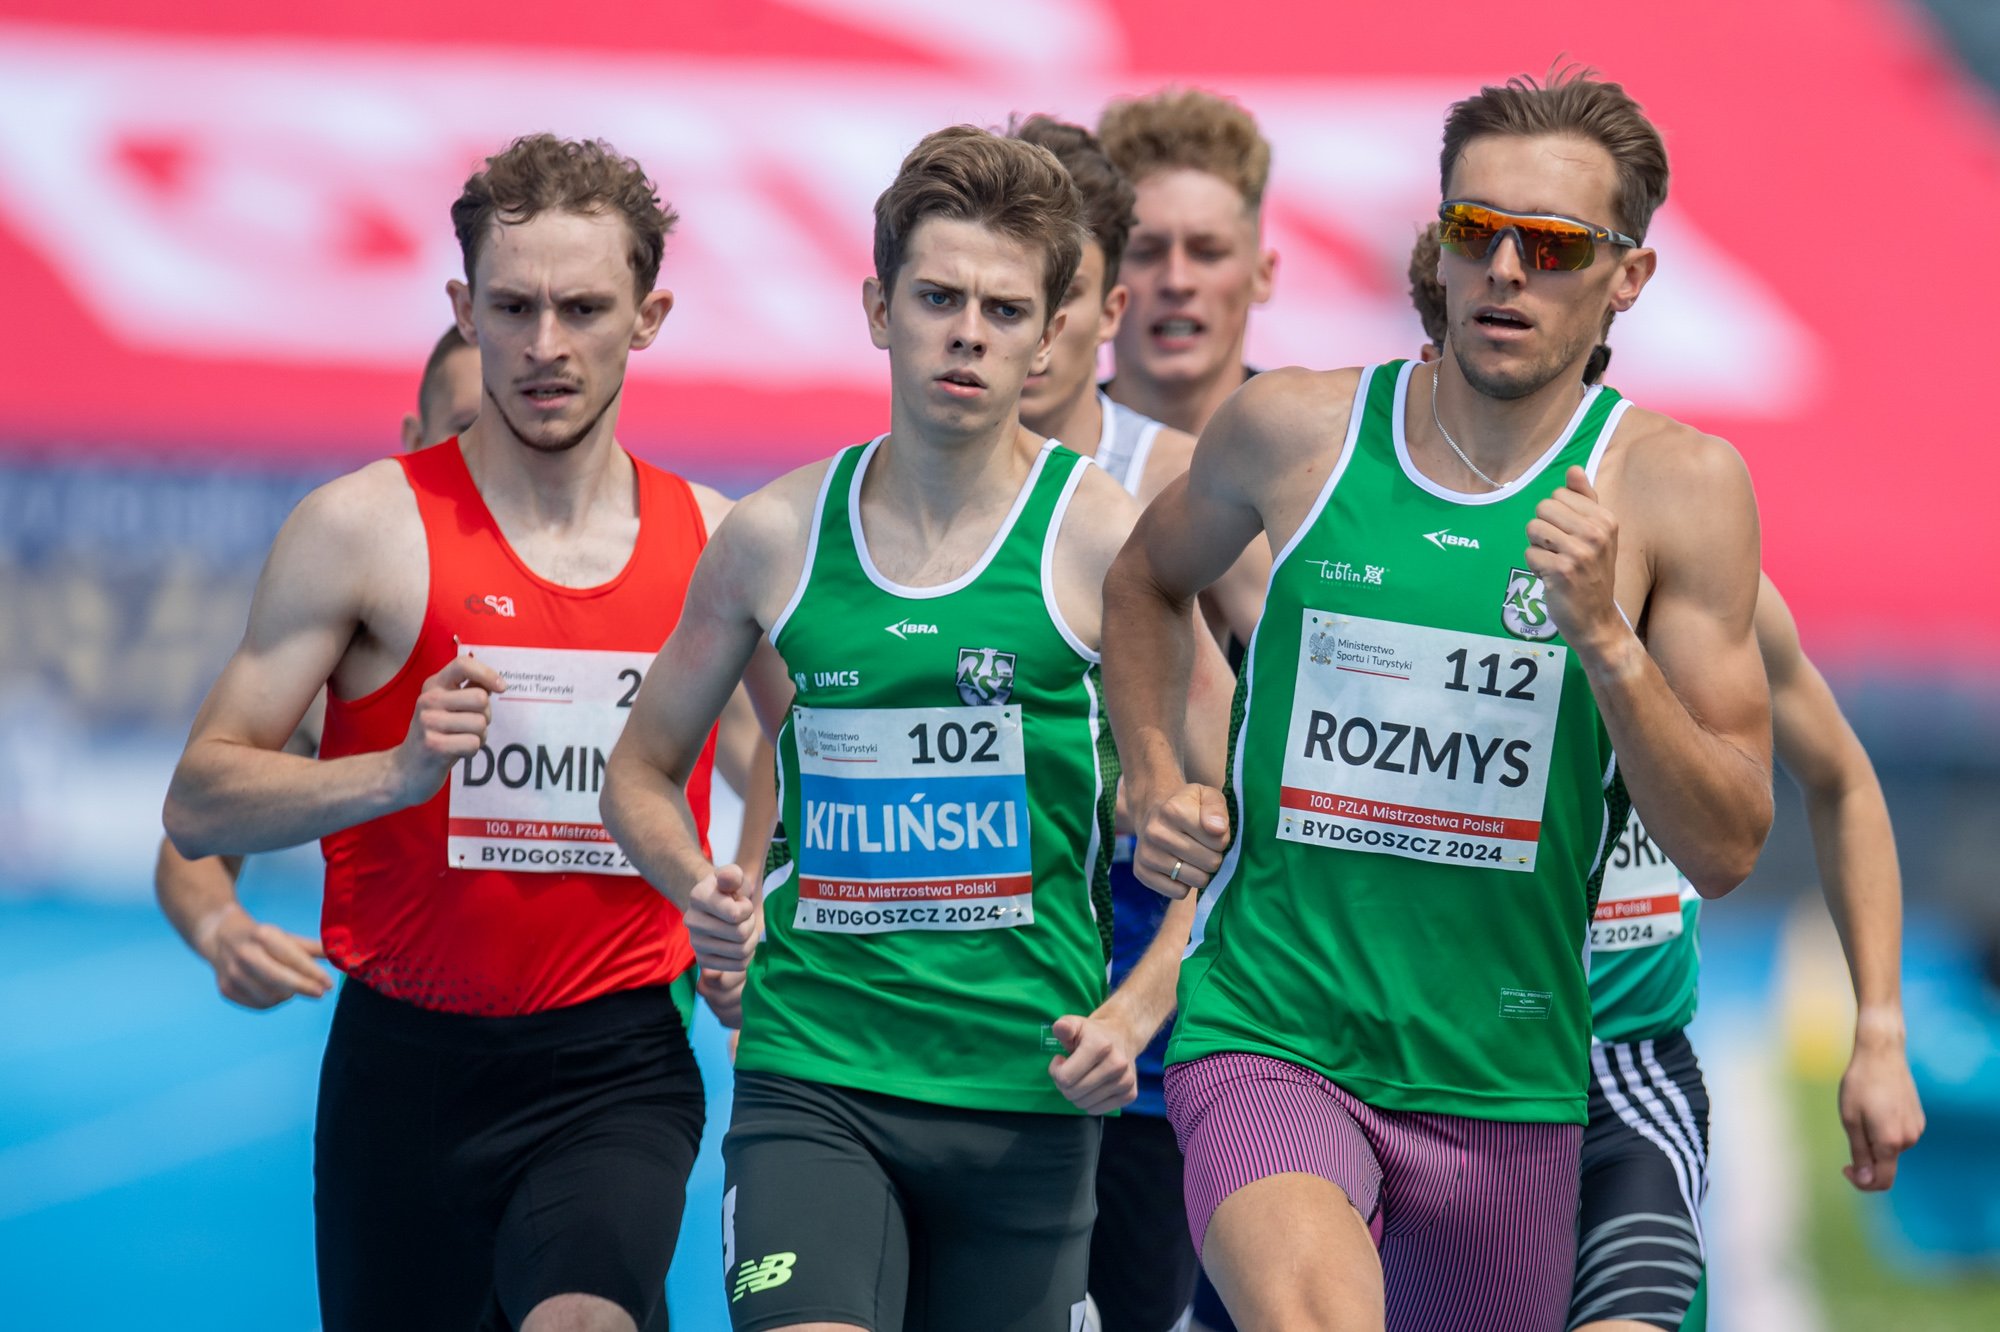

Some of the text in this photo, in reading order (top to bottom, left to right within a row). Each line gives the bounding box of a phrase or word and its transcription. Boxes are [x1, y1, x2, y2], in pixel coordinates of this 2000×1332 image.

[1441, 534, 1480, 549] IBRA
[901, 623, 939, 634] IBRA
[1337, 638, 1395, 656] Ministerstwo
[1336, 650, 1365, 663] Sportu
[1371, 656, 1413, 671] Turystyki
[499, 670, 555, 682] Ministerstwo
[814, 670, 859, 688] UMCS
[1444, 648, 1539, 701] 112
[841, 743, 878, 754] Turystyki
[907, 720, 1000, 765] 102
[1303, 710, 1532, 788] ROZMYS
[805, 793, 1019, 853] KITLIŃSKI
[1309, 795, 1505, 834] 100. PZLA Mistrzostwa Polski
[485, 821, 512, 836] 100.
[516, 824, 548, 837] PZLA
[1301, 819, 1503, 863] BYDGOSZCZ 2024
[481, 846, 615, 868] BYDGOSZCZ
[818, 881, 997, 899] 100. PZLA Mistrzostwa Polski
[816, 904, 1001, 926] BYDGOSZCZ 2024
[1615, 898, 1652, 917] Polski
[1605, 924, 1653, 944] 2024
